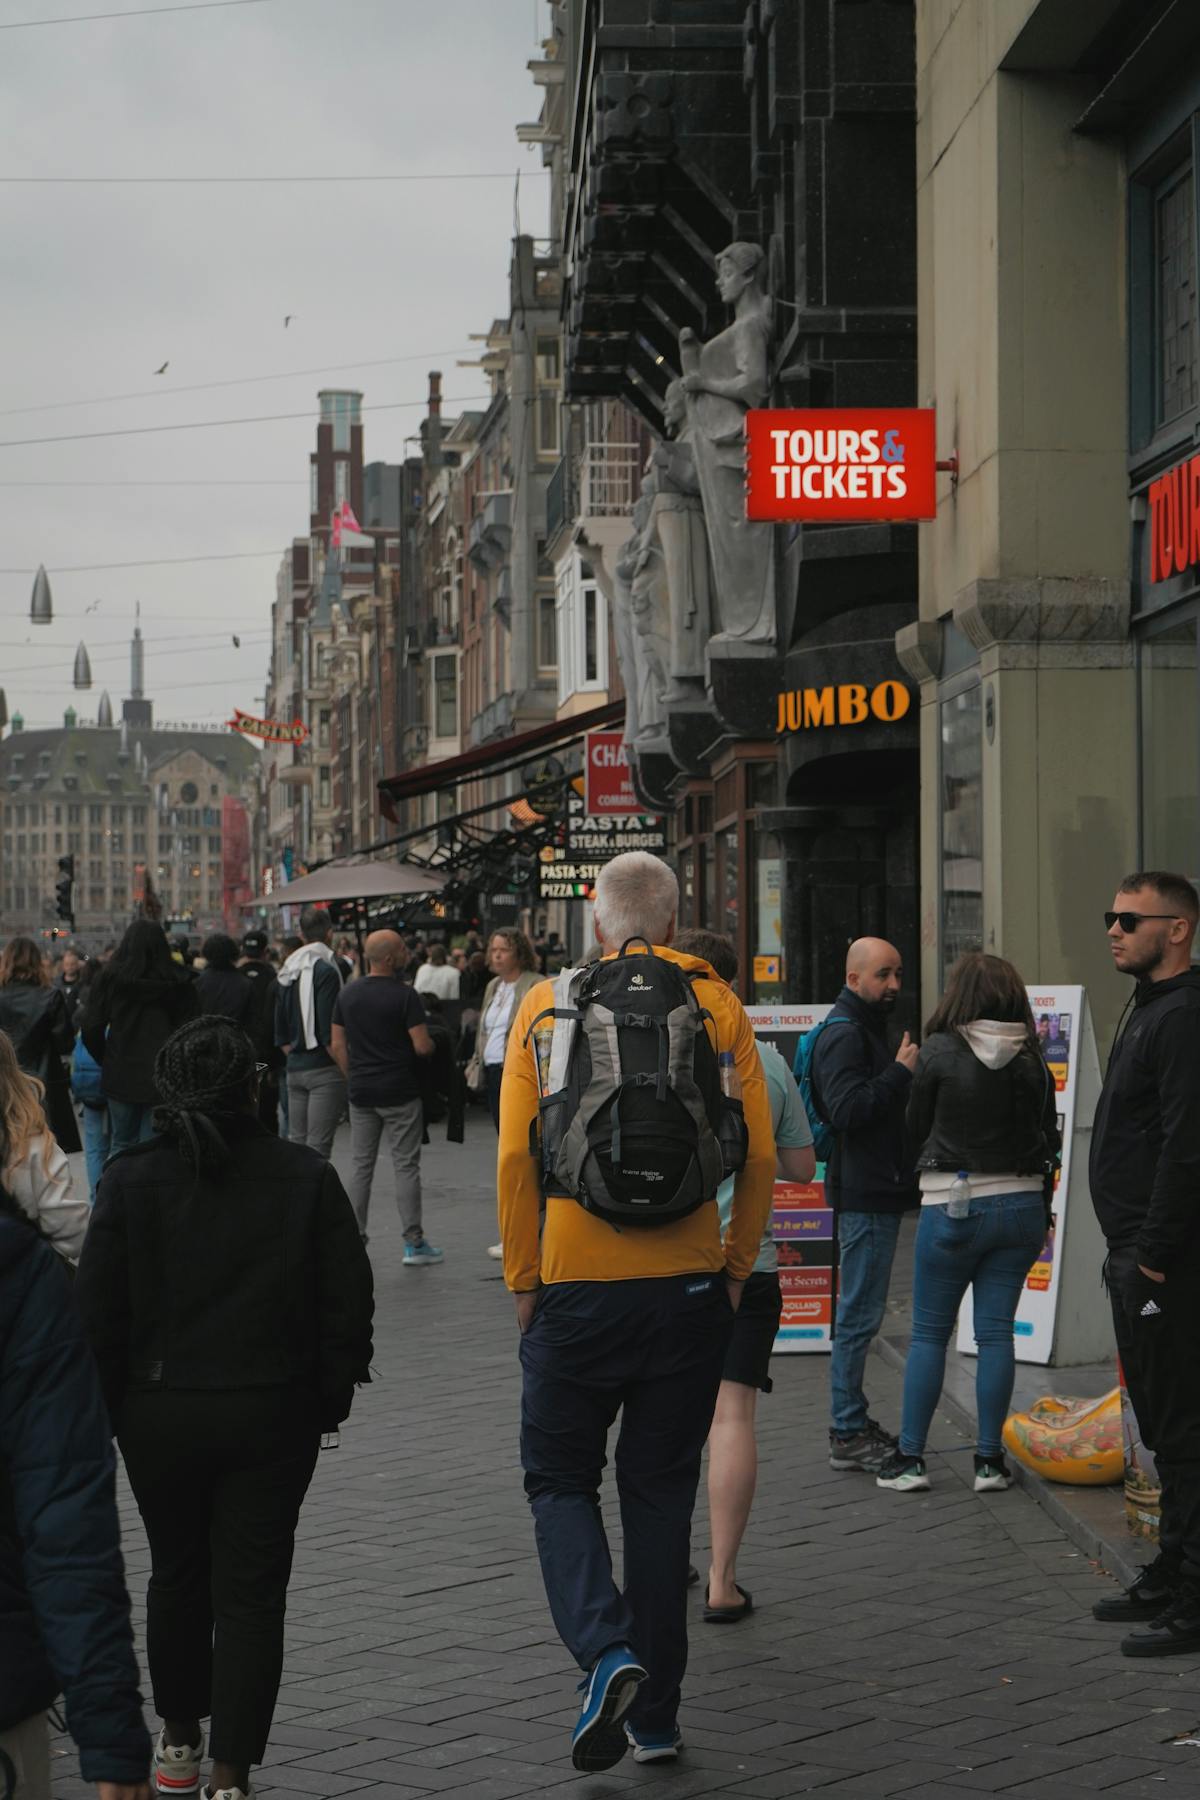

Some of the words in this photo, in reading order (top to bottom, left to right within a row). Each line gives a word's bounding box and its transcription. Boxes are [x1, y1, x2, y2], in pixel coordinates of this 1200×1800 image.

[770, 465, 907, 499] TICKETS
[776, 680, 911, 734] JUMBO
[238, 717, 304, 740] CASINO
[591, 744, 629, 767] CHA
[597, 794, 638, 806] COMMIS
[568, 816, 643, 831] PASTA
[540, 864, 602, 880] PASTA-STE
[540, 883, 574, 898] PIZZA
[627, 984, 654, 992] deuter
[794, 1276, 828, 1287] Secrets
